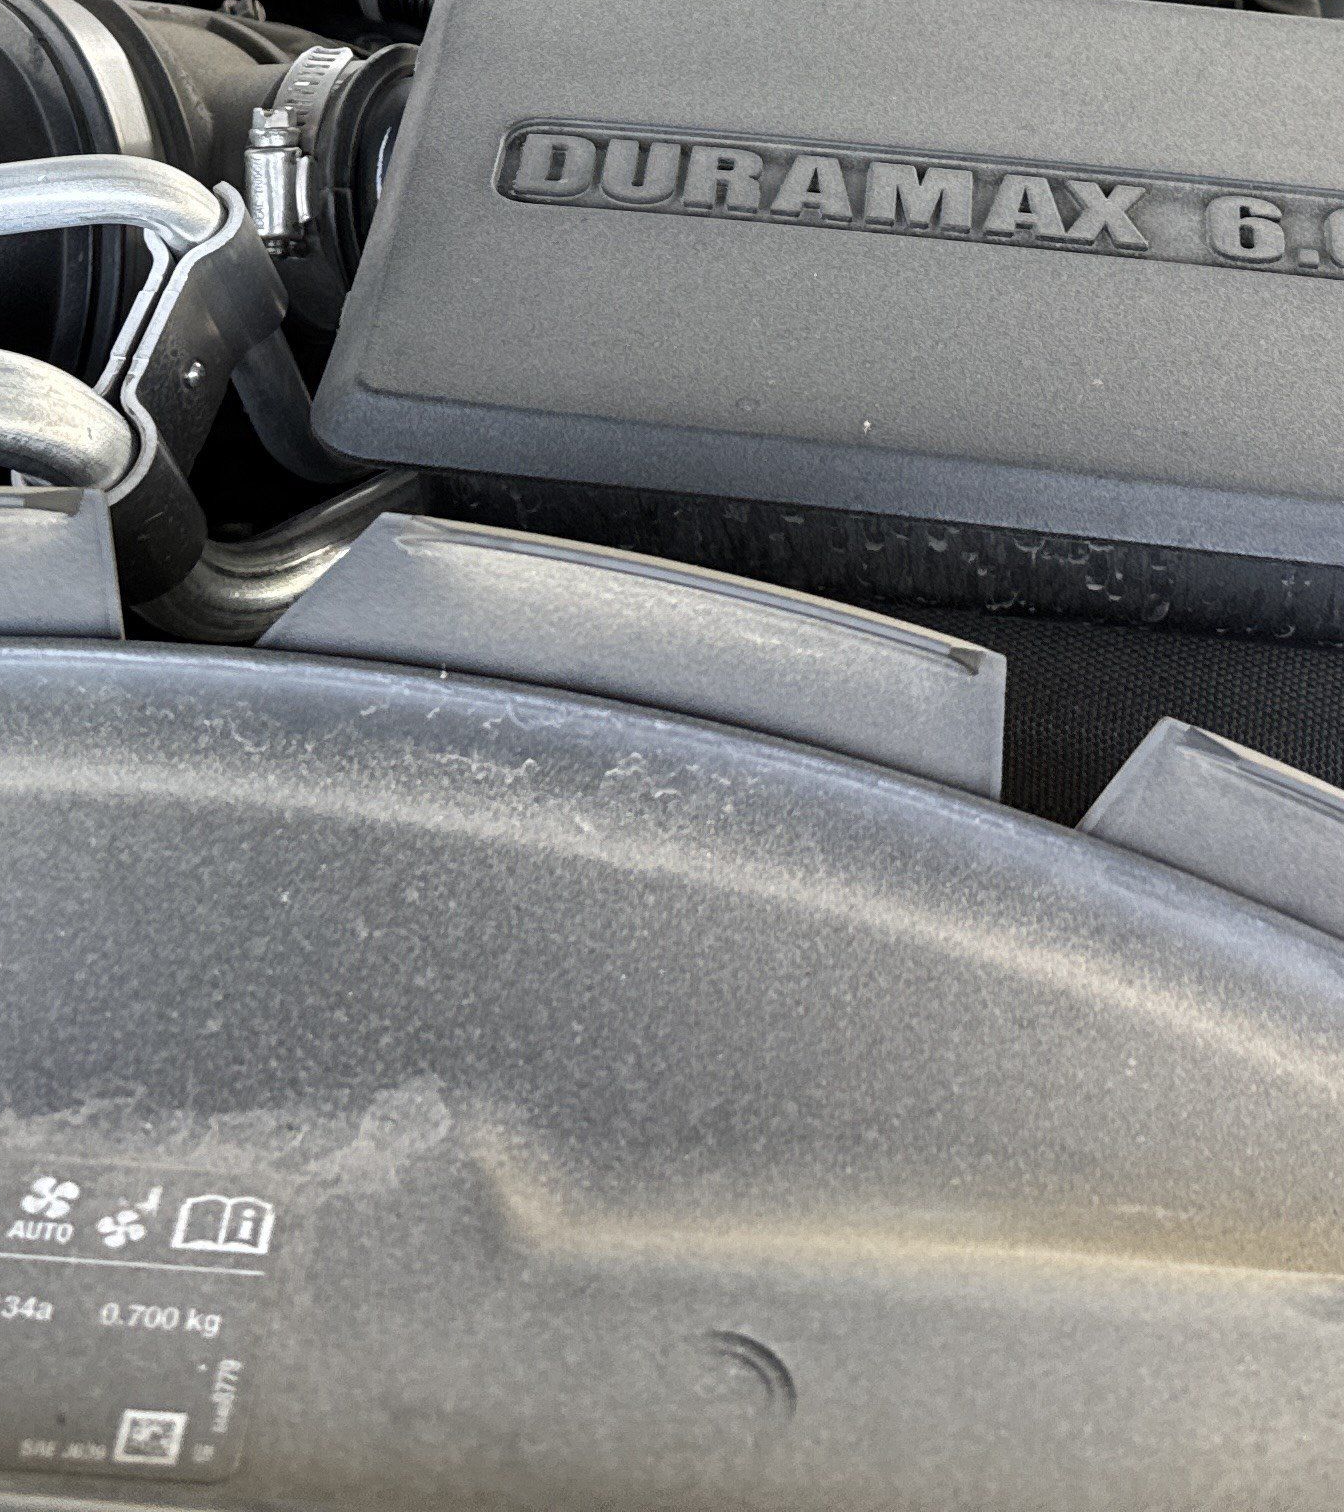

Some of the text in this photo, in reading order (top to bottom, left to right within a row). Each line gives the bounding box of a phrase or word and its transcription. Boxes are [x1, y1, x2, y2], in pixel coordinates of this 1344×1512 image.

[510, 132, 1149, 252] DURAMAX
[7, 1219, 75, 1245] AUTO
[100, 1301, 181, 1331] 0.700
[185, 1307, 223, 1339] kg
